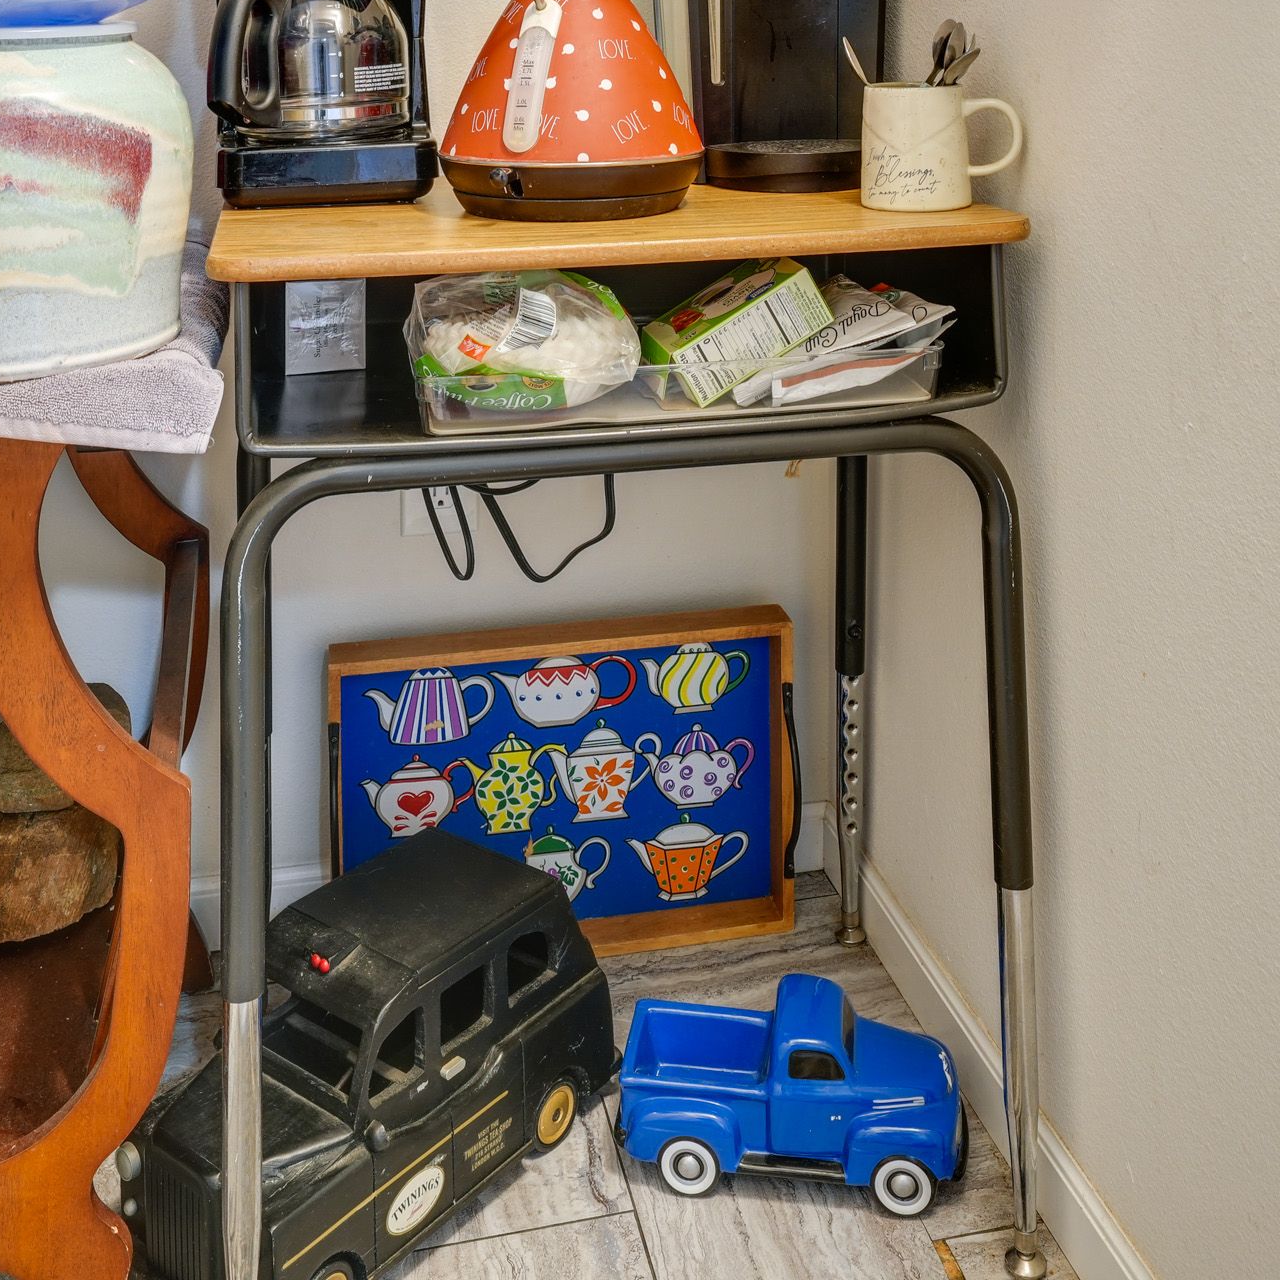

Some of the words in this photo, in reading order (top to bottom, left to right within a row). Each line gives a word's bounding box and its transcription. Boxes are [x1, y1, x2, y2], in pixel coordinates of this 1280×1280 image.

[598, 39, 637, 61] LOVE.
[471, 108, 501, 133] LOVE.
[610, 109, 651, 145] LOVE.
[838, 300, 892, 335] Royal
[805, 326, 838, 353] Cup
[482, 391, 552, 410] Coffee
[691, 372, 710, 402] Nutrition
[464, 1135, 489, 1161] TWININGS
[391, 1175, 441, 1222] TWININGS
